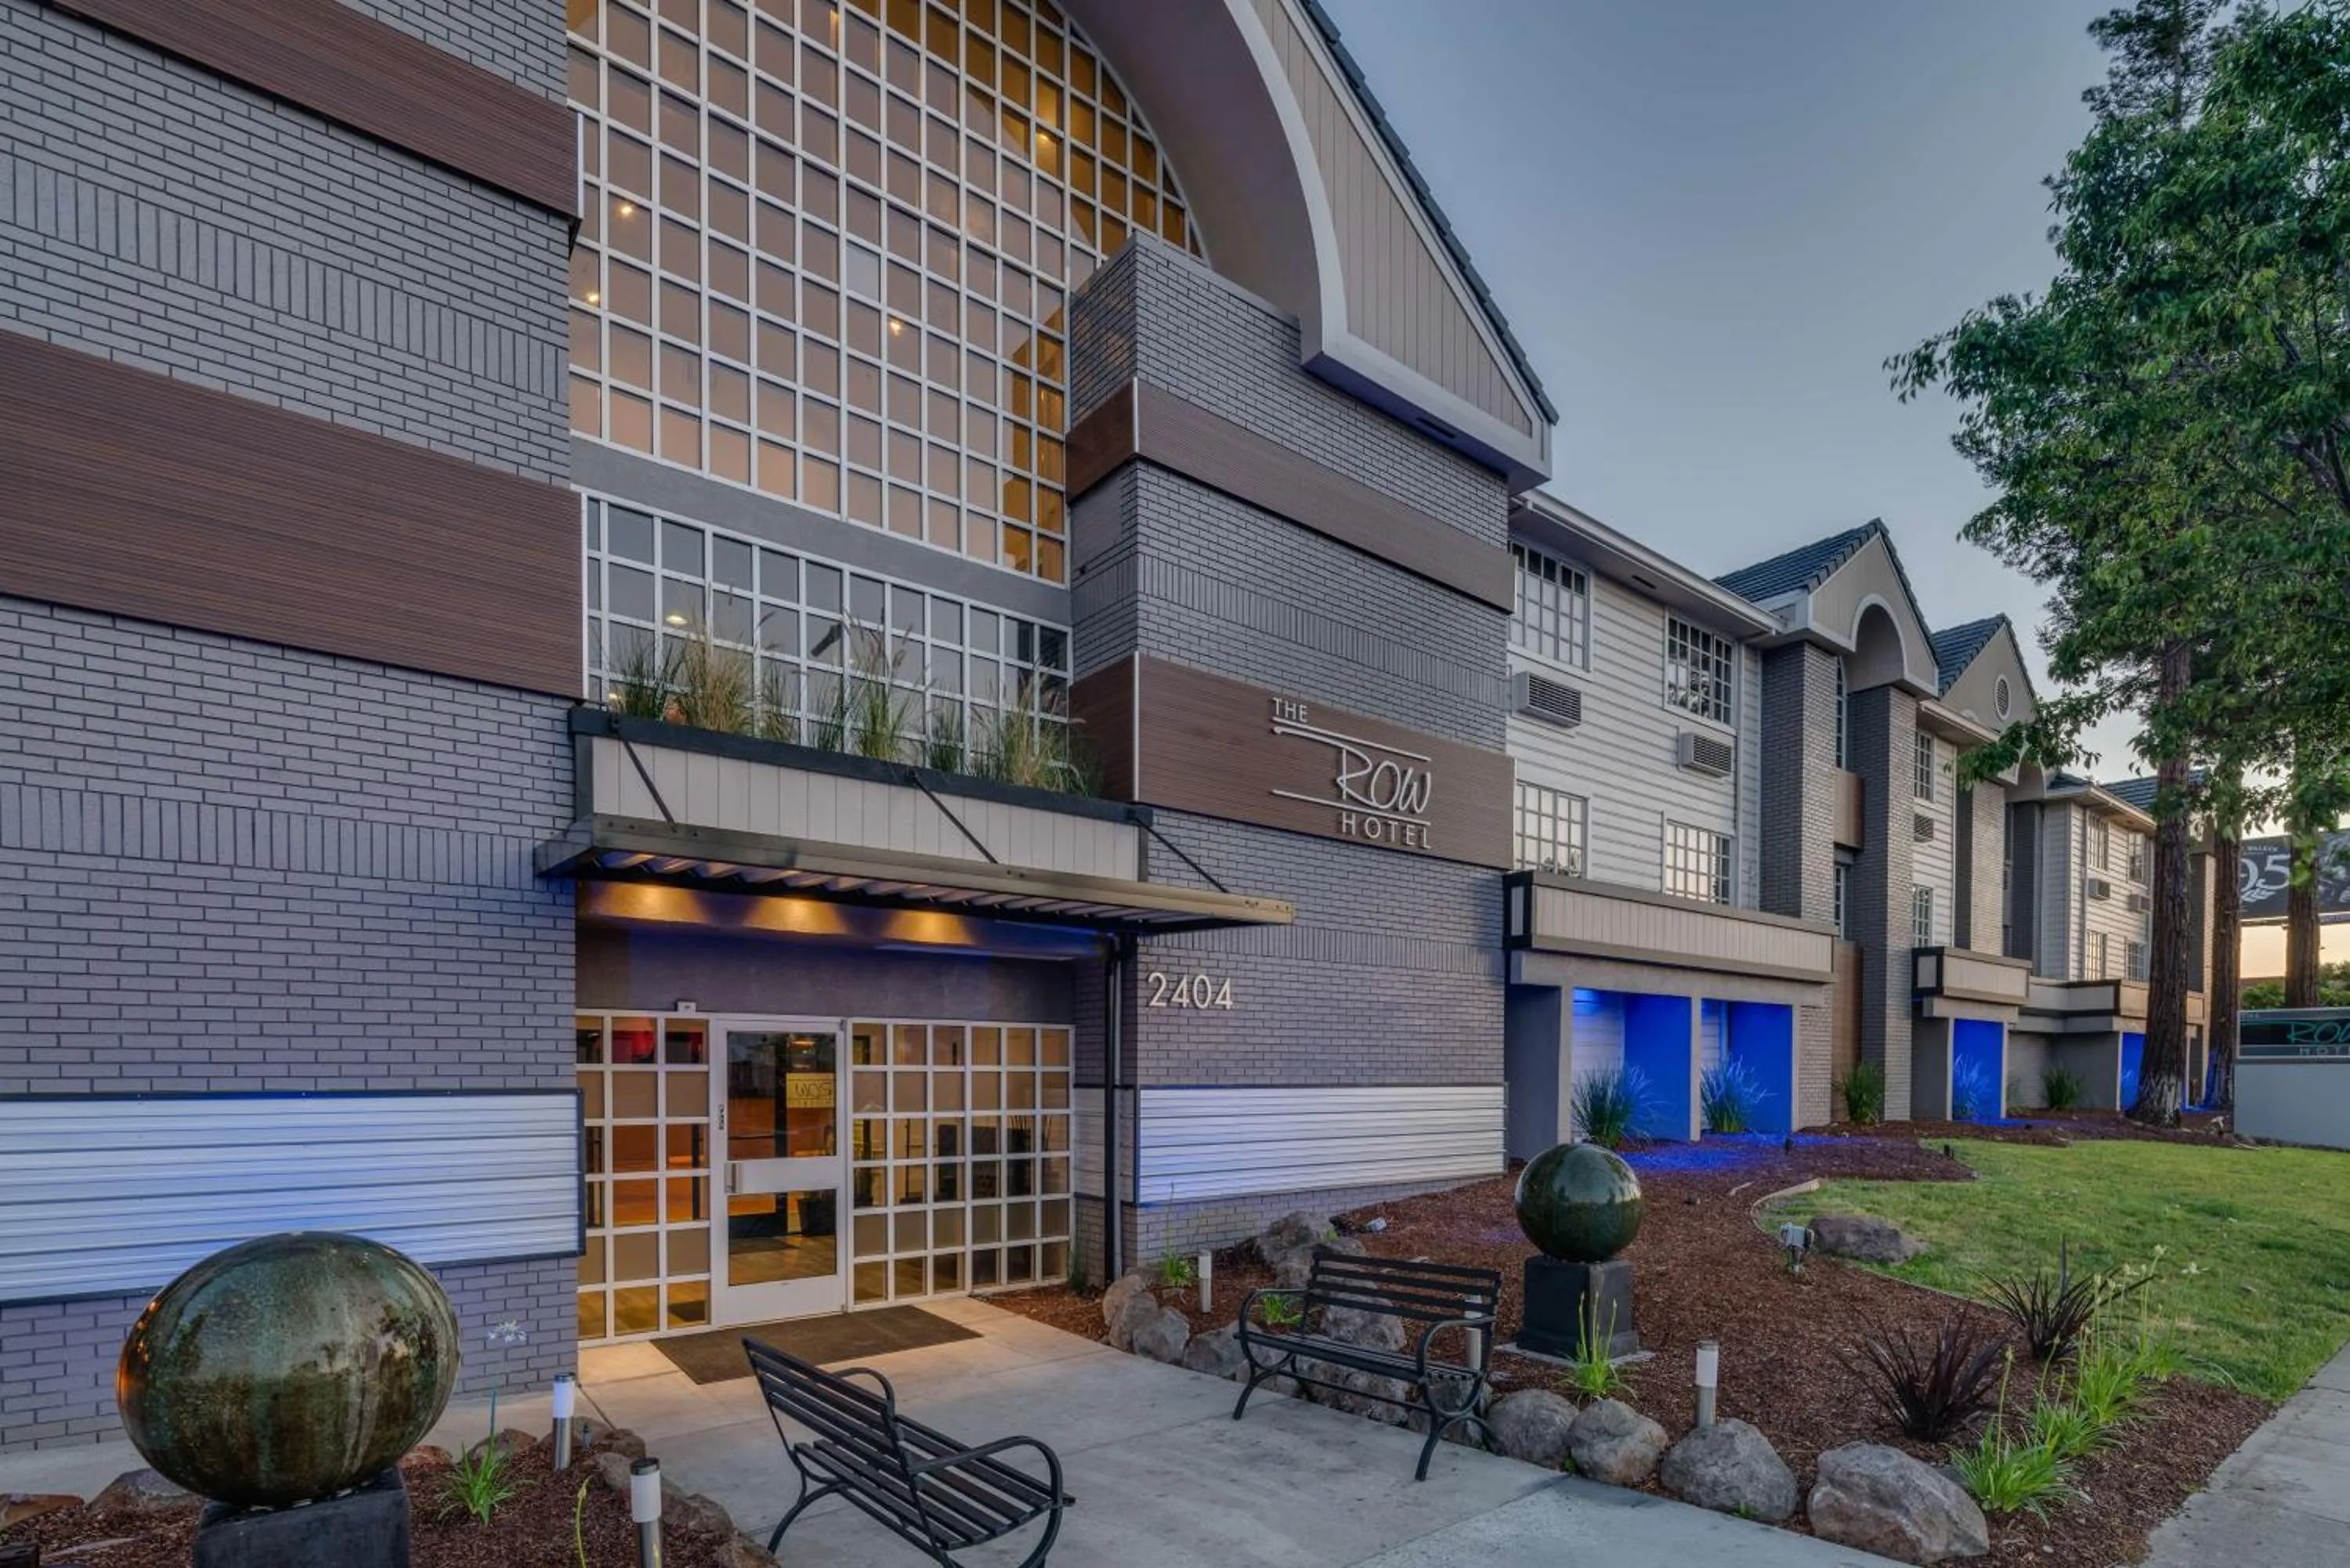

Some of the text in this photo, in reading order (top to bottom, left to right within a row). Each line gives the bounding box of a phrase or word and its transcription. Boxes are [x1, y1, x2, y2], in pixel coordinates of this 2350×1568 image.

[1272, 698, 1308, 723] THE
[1336, 744, 1432, 814] ROW
[1342, 811, 1432, 850] HOTEL
[1148, 972, 1234, 1010] 2404
